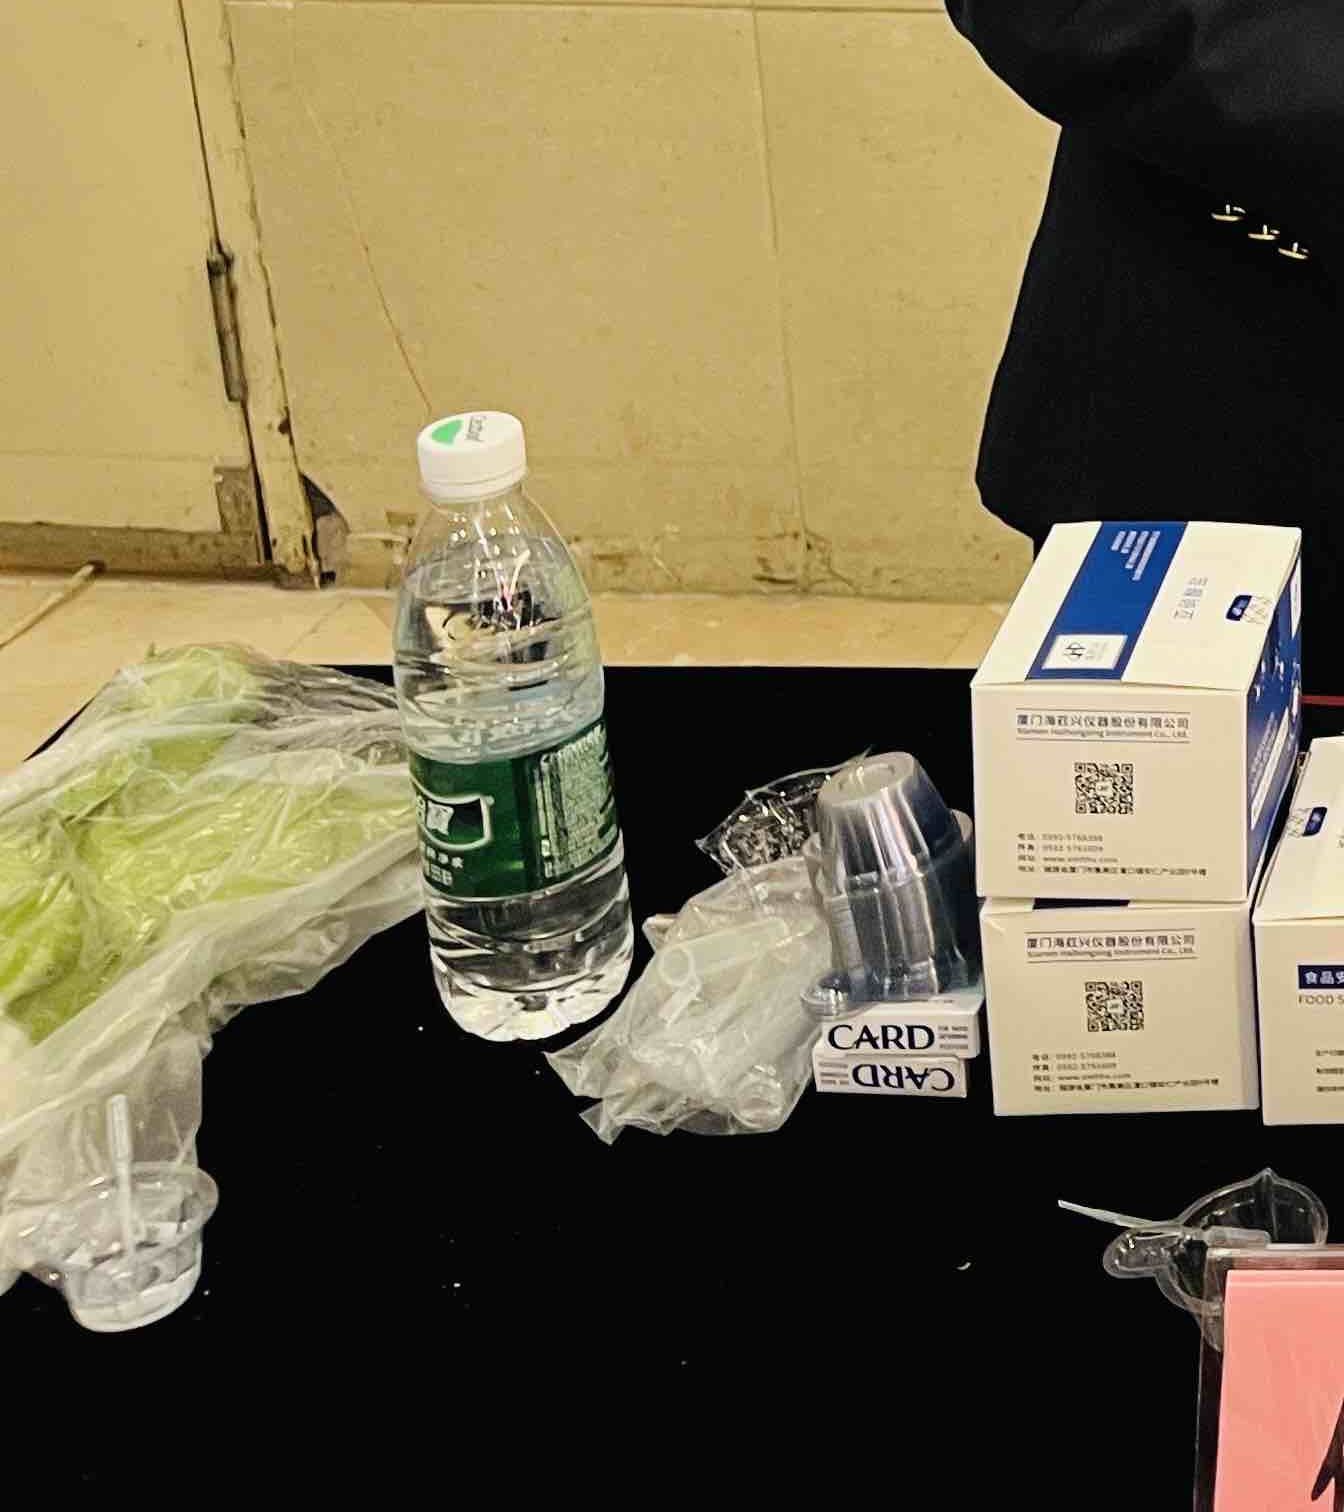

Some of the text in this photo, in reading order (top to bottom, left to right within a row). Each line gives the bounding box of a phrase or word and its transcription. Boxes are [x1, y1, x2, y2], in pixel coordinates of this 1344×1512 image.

[1298, 994, 1334, 1006] FOOD
[828, 1024, 935, 1050] CARD
[852, 1064, 956, 1092] CARD
